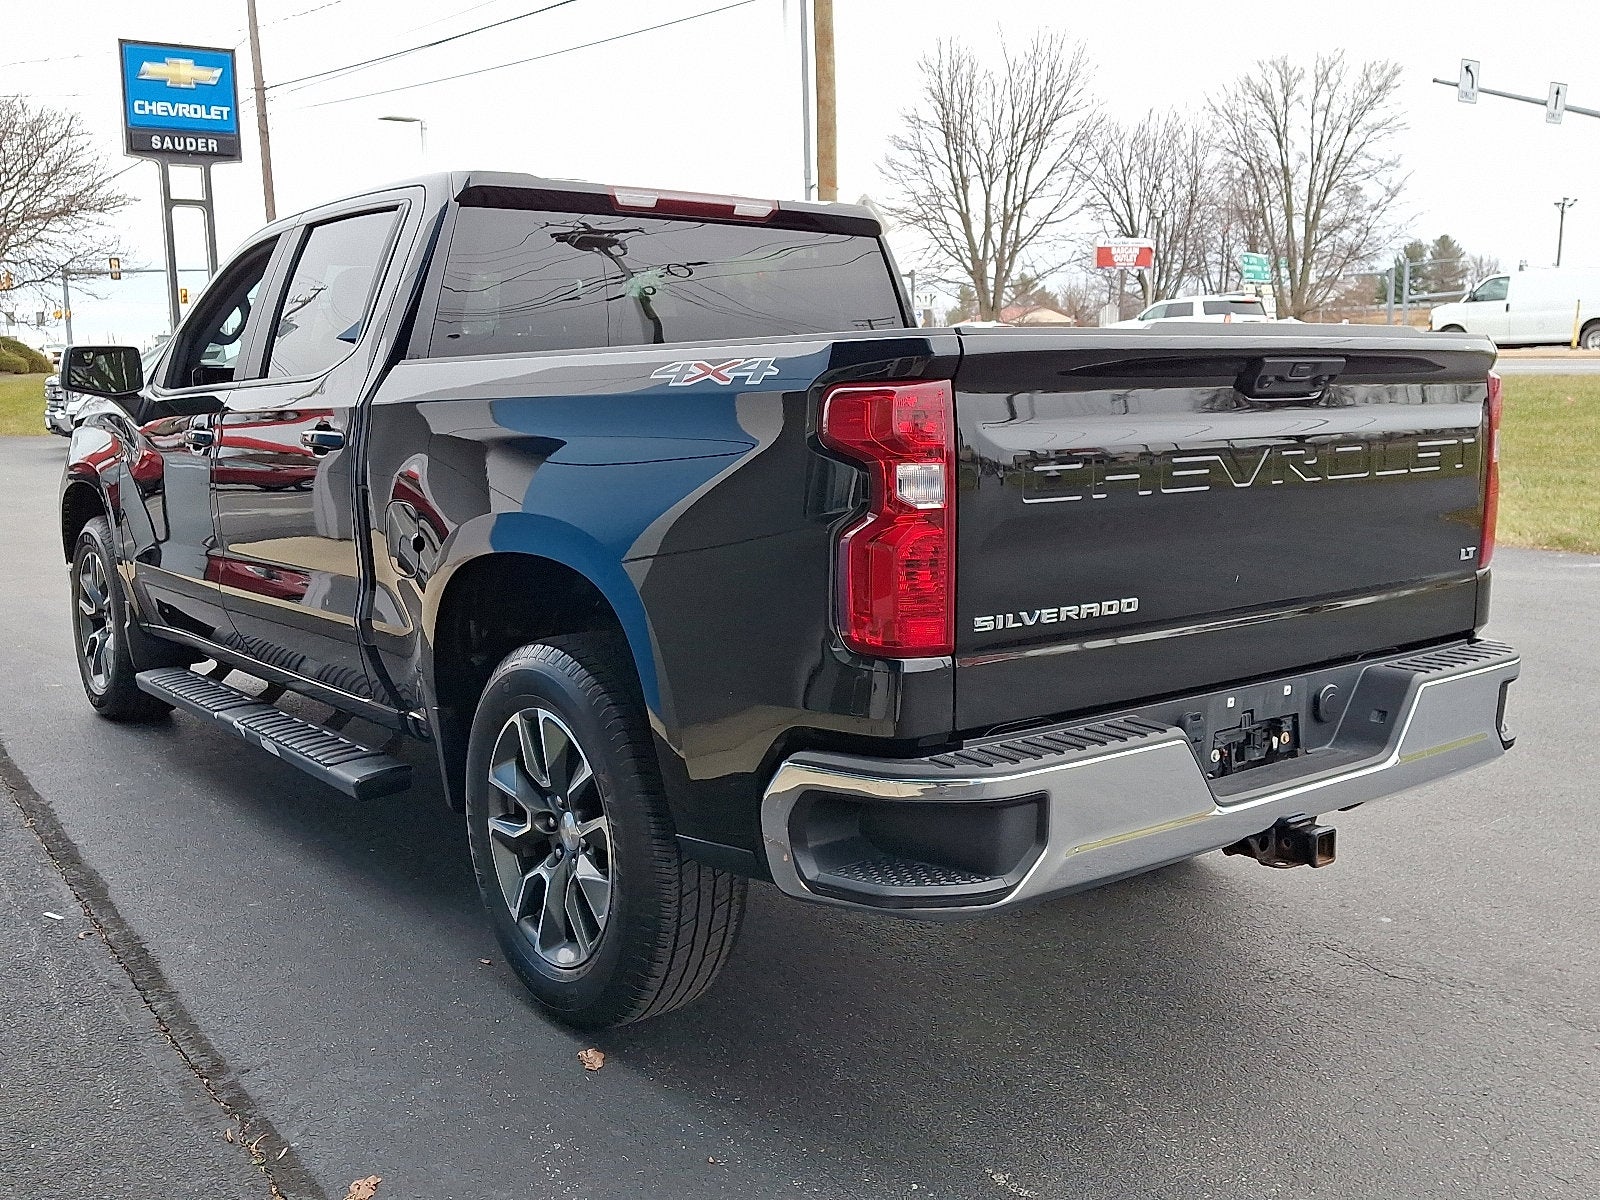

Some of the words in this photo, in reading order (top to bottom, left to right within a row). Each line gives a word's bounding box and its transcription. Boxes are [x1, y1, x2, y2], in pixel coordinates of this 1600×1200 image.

[133, 99, 231, 120] CHEVROLET
[151, 135, 218, 152] SAUDER
[1023, 437, 1476, 504] CHEVROLET
[1460, 546, 1477, 560] LT
[973, 597, 1139, 632] SILVERADO
